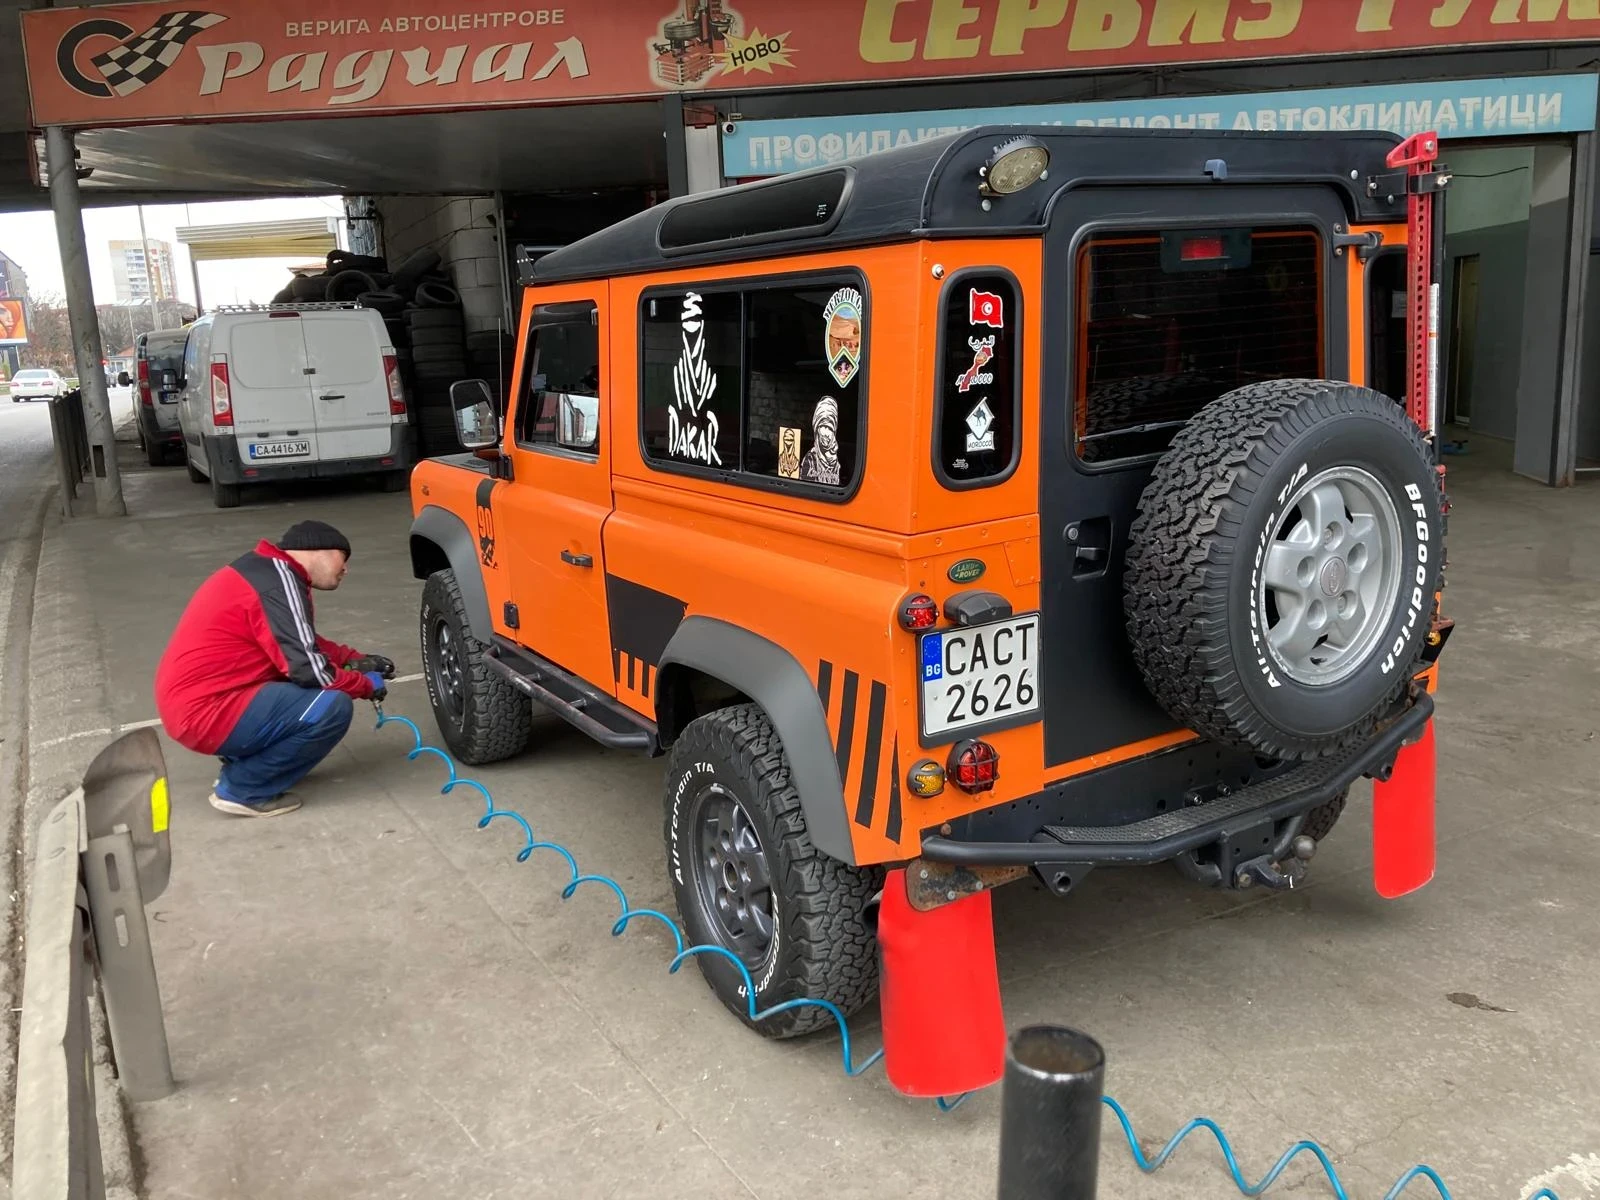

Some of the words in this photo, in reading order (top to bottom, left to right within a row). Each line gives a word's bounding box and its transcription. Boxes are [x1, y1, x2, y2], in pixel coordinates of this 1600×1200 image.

[285, 18, 371, 37] ВЕРИГА
[379, 8, 565, 34] АВТОЦЕНТРОВЕ
[730, 38, 782, 67] НОВО
[195, 35, 591, 106] Радиал
[1231, 92, 1563, 131] АВТОКЛИМАТИЦИ
[668, 404, 722, 466] DAKAR
[1250, 512, 1282, 688] All-Terrain
[1278, 462, 1309, 506] T/A
[1381, 483, 1429, 674] BFGoodrich
[925, 663, 941, 677] BG
[946, 668, 1034, 723] 2626
[671, 769, 693, 886] All-Terrain
[694, 761, 715, 775] T/A
[737, 890, 780, 998] BFGoodrih
